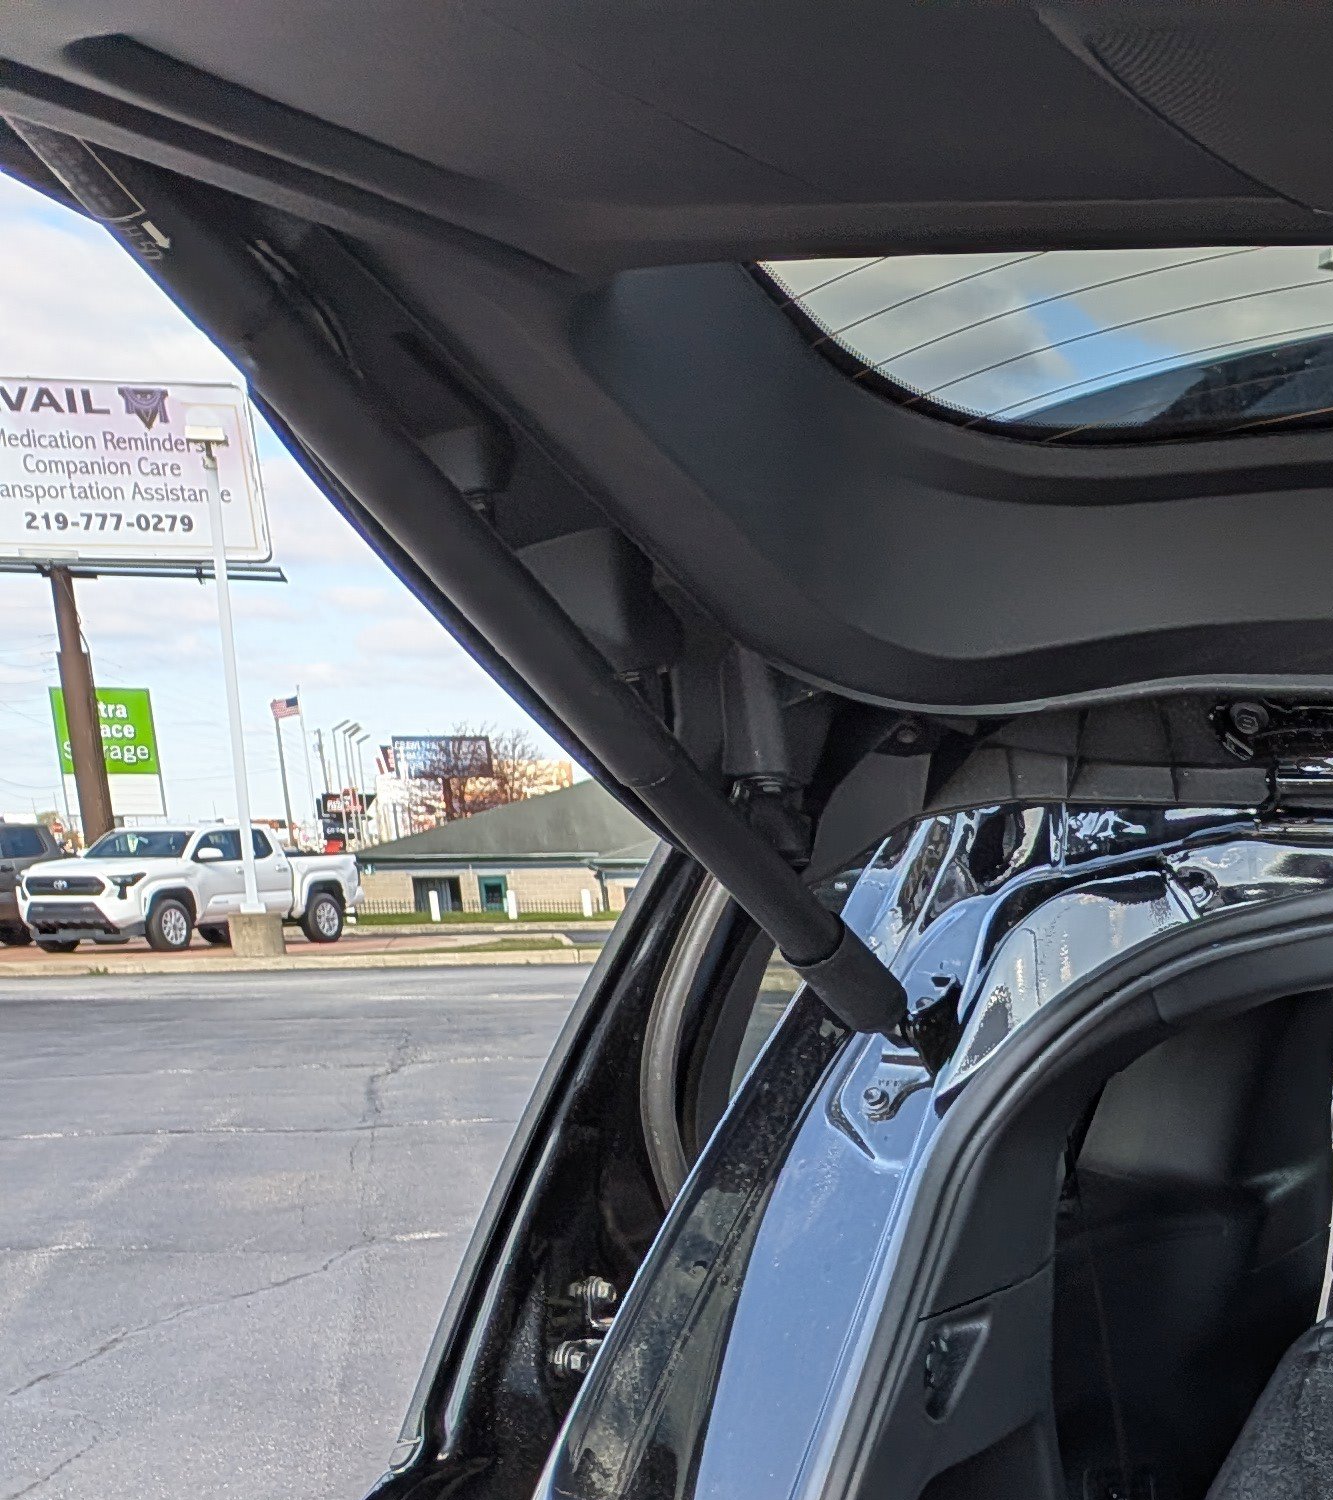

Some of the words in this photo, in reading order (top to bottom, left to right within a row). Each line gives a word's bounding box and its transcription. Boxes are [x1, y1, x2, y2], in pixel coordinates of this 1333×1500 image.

[22, 453, 132, 480] Companion
[137, 456, 182, 477] Care
[0, 481, 125, 504] ansportation
[131, 481, 232, 503] Assistane
[24, 511, 194, 533] 219-777-0279
[97, 701, 128, 718] tra
[100, 724, 135, 739] ace
